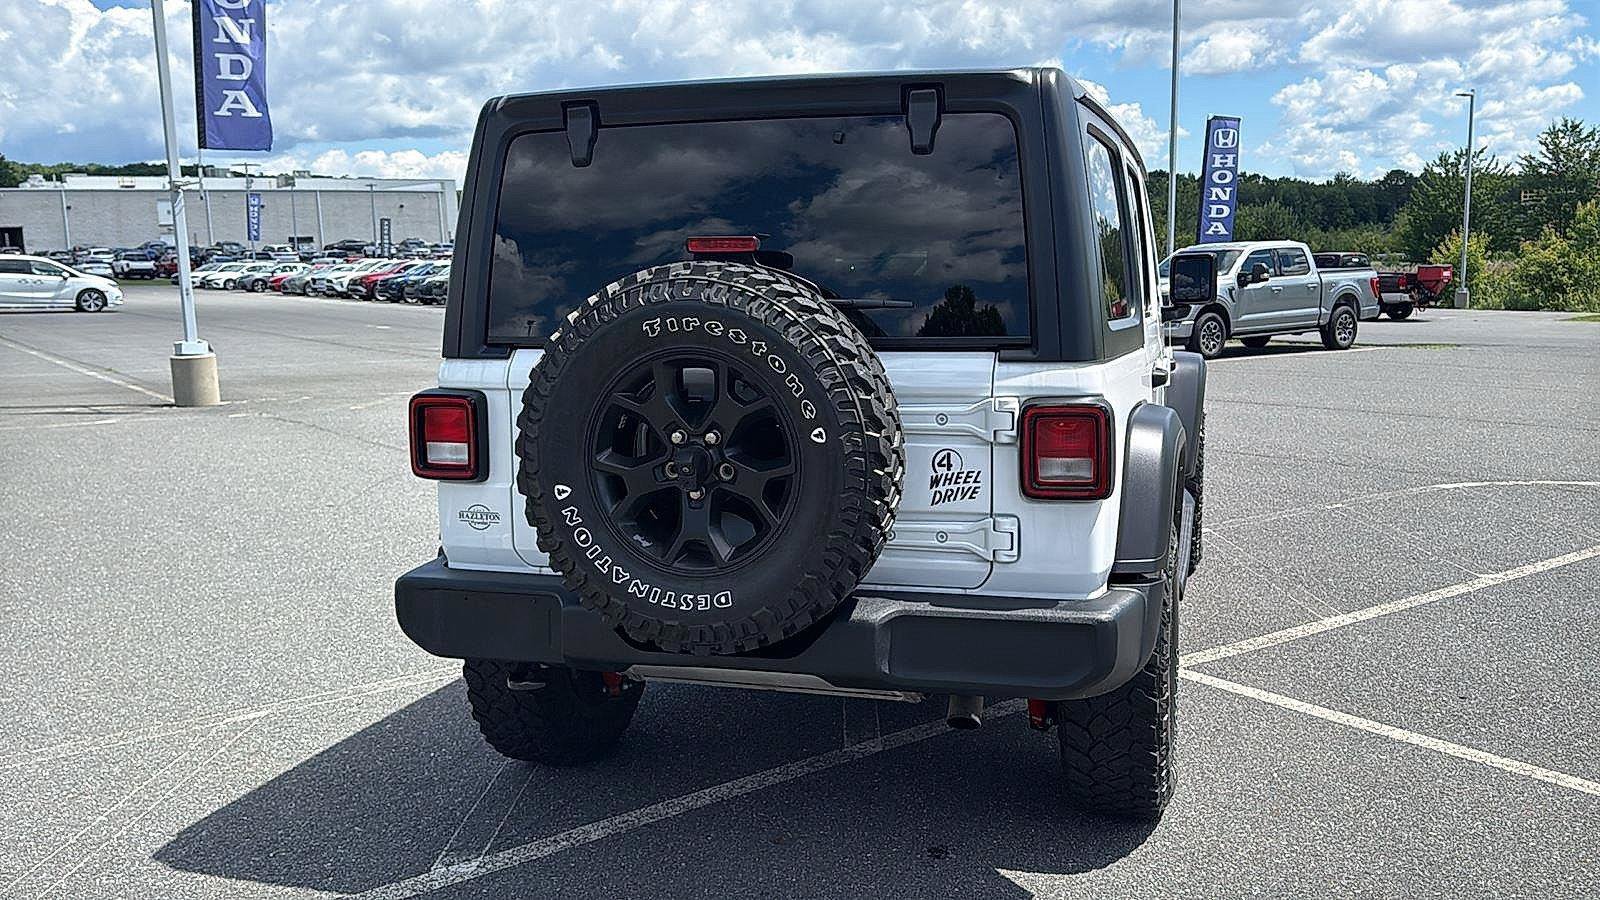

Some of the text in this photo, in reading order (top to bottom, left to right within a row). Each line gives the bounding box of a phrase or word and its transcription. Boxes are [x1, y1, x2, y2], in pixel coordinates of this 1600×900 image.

[1205, 153, 1237, 236] HONDA
[642, 317, 817, 420] Firestone
[936, 452, 953, 471] 4
[929, 470, 982, 490] WHEEL
[930, 486, 981, 507] DRIVE
[458, 511, 501, 521] HAZLETON
[562, 505, 733, 611] DESTINATION
